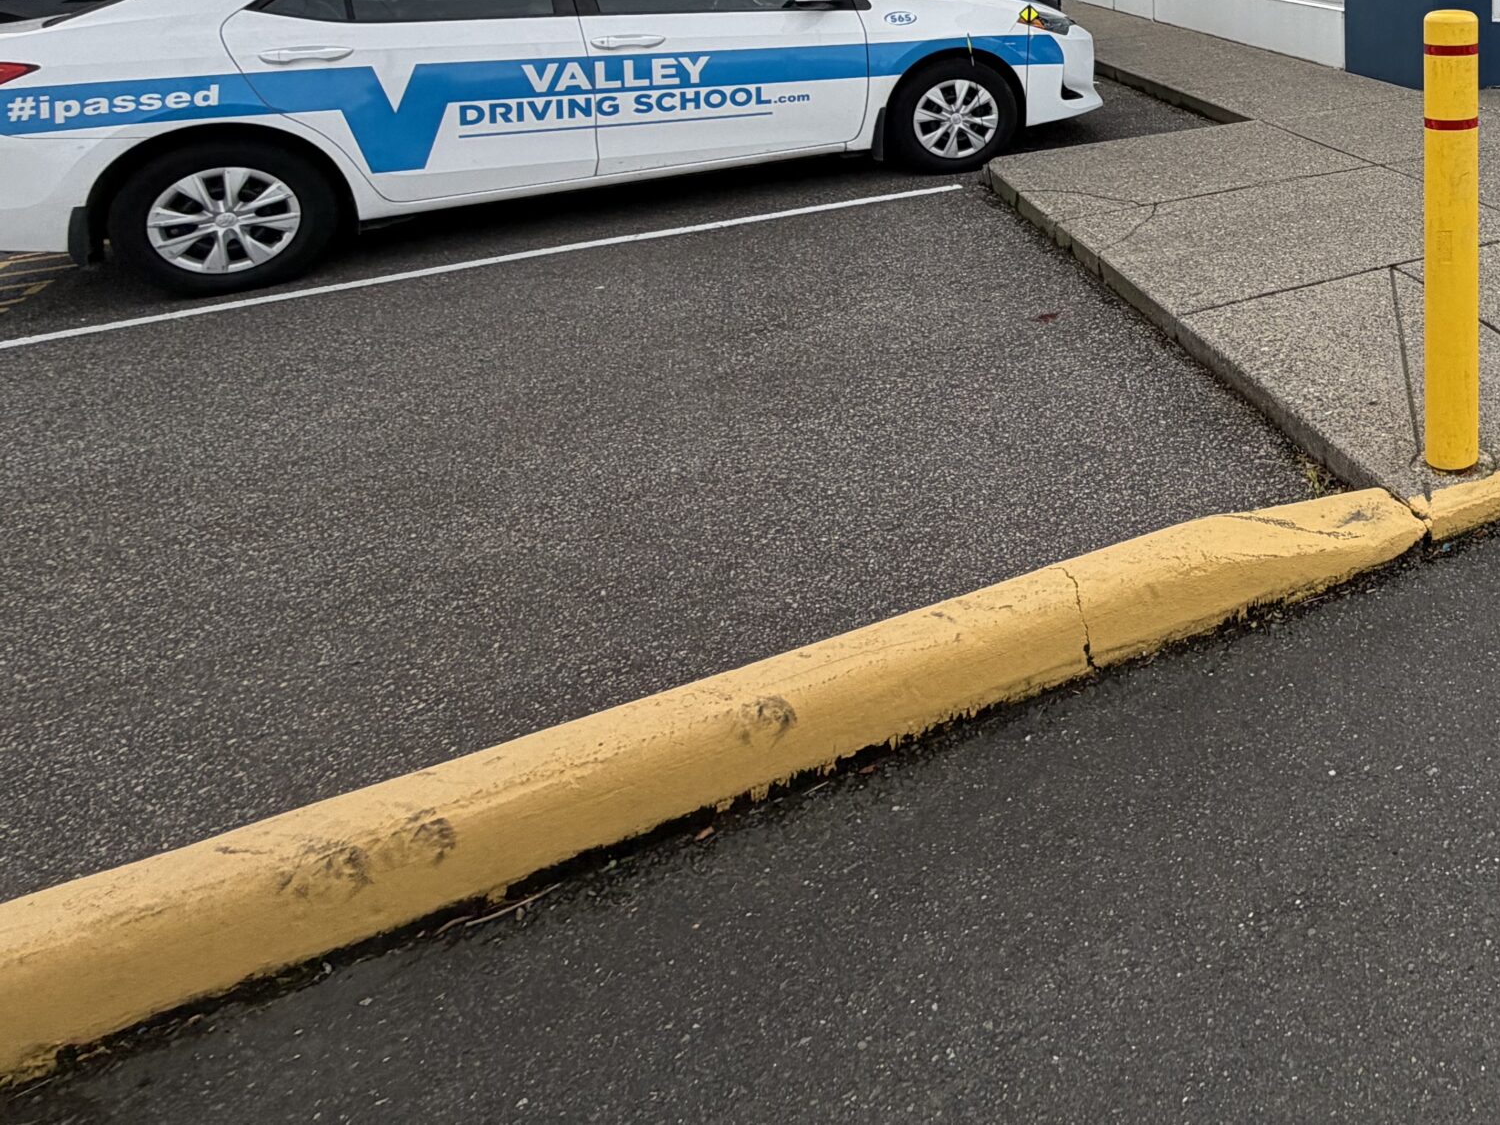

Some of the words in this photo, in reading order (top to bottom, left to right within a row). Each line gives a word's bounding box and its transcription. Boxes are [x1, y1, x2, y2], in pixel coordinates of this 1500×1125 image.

[890, 13, 912, 24] 565
[522, 56, 711, 93] VALLEY
[6, 84, 220, 124] #ipassed
[459, 95, 621, 127] DRIVING
